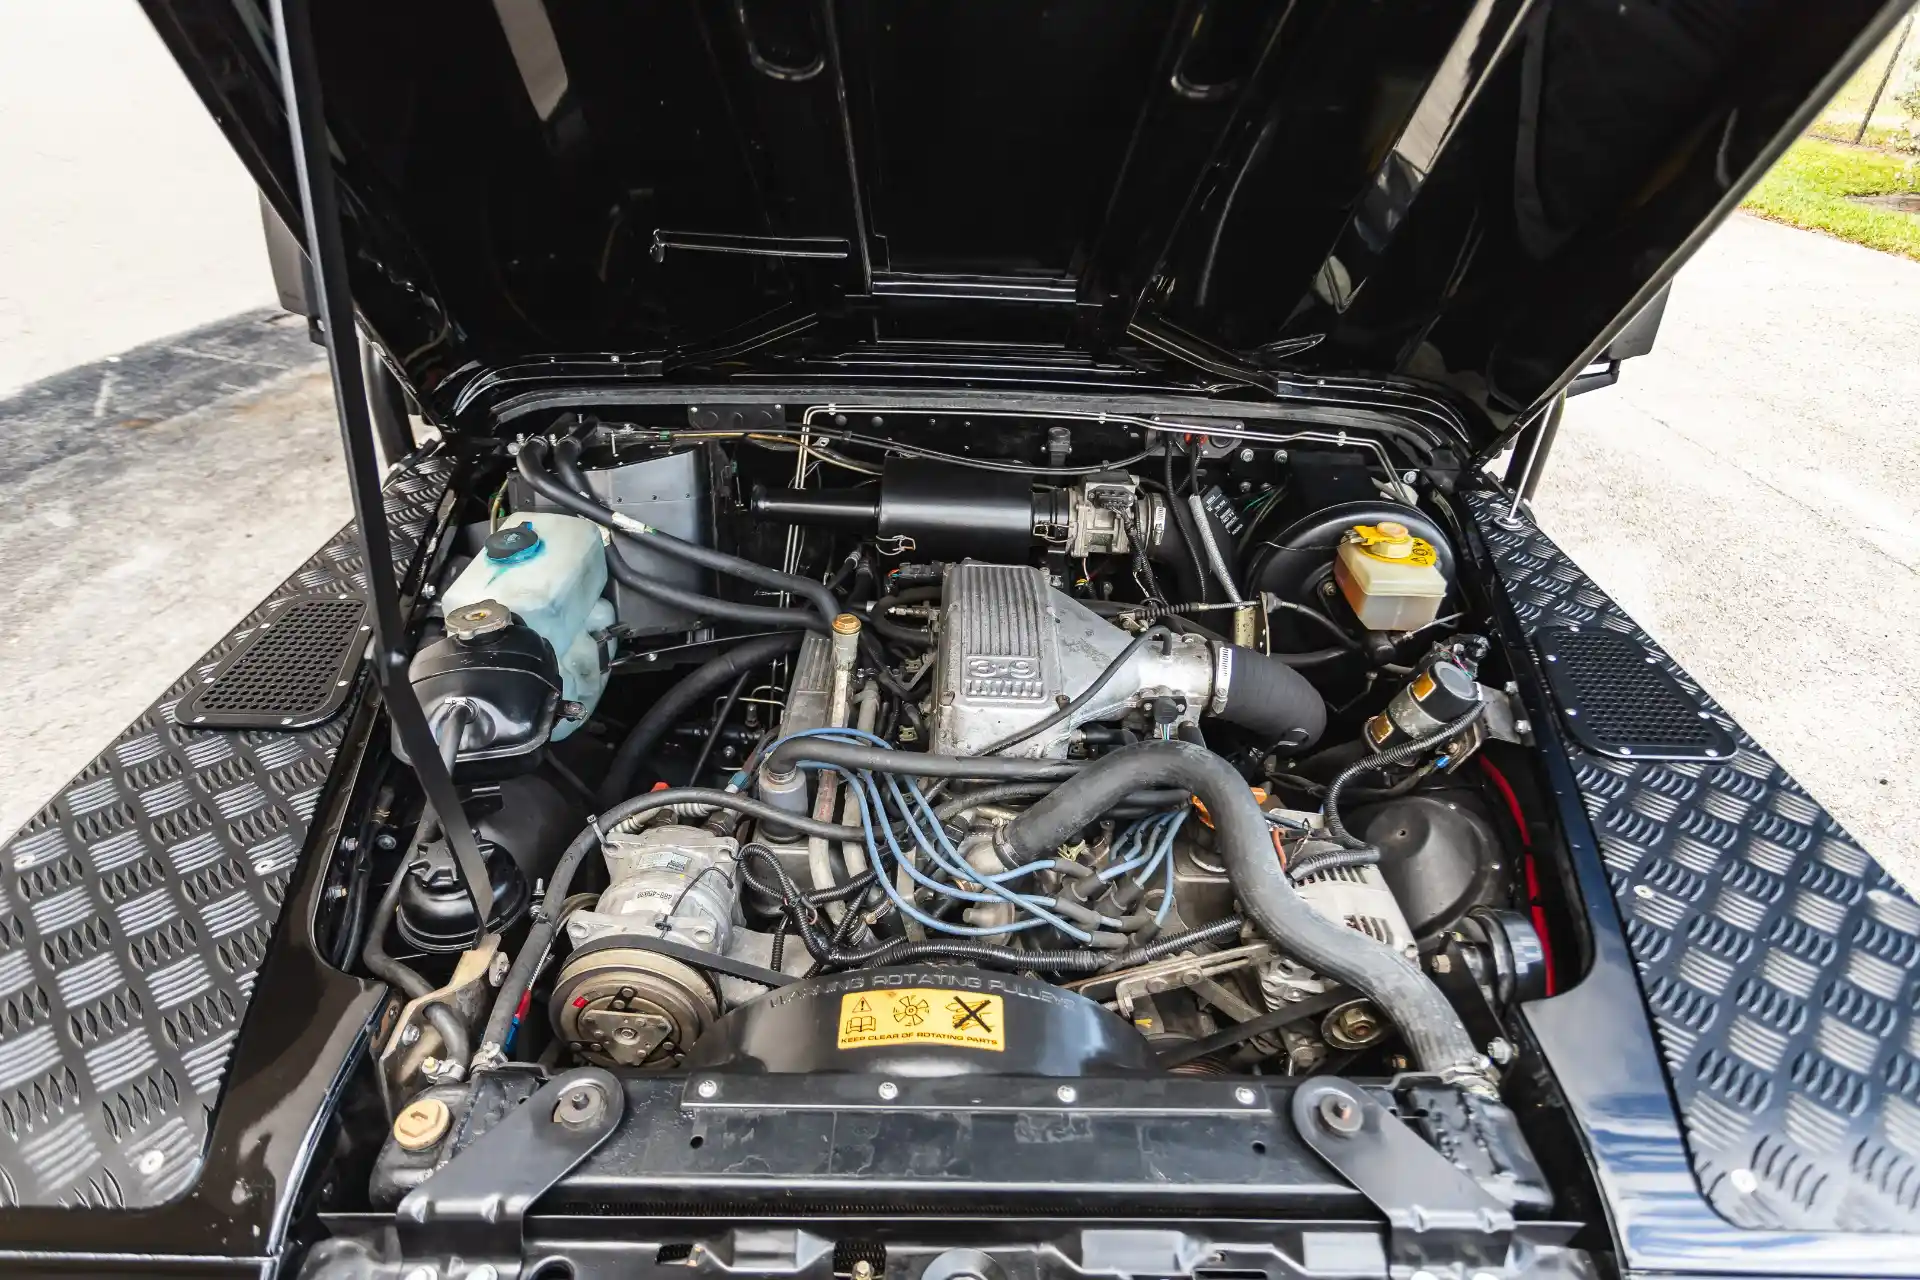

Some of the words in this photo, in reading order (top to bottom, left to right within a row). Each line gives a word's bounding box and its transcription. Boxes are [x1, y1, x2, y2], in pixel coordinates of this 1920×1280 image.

[872, 974, 982, 989] ROTATING
[868, 1033, 899, 1041] CLEAR
[916, 1032, 964, 1041] ROTATING
[966, 1036, 998, 1045] PARTS
